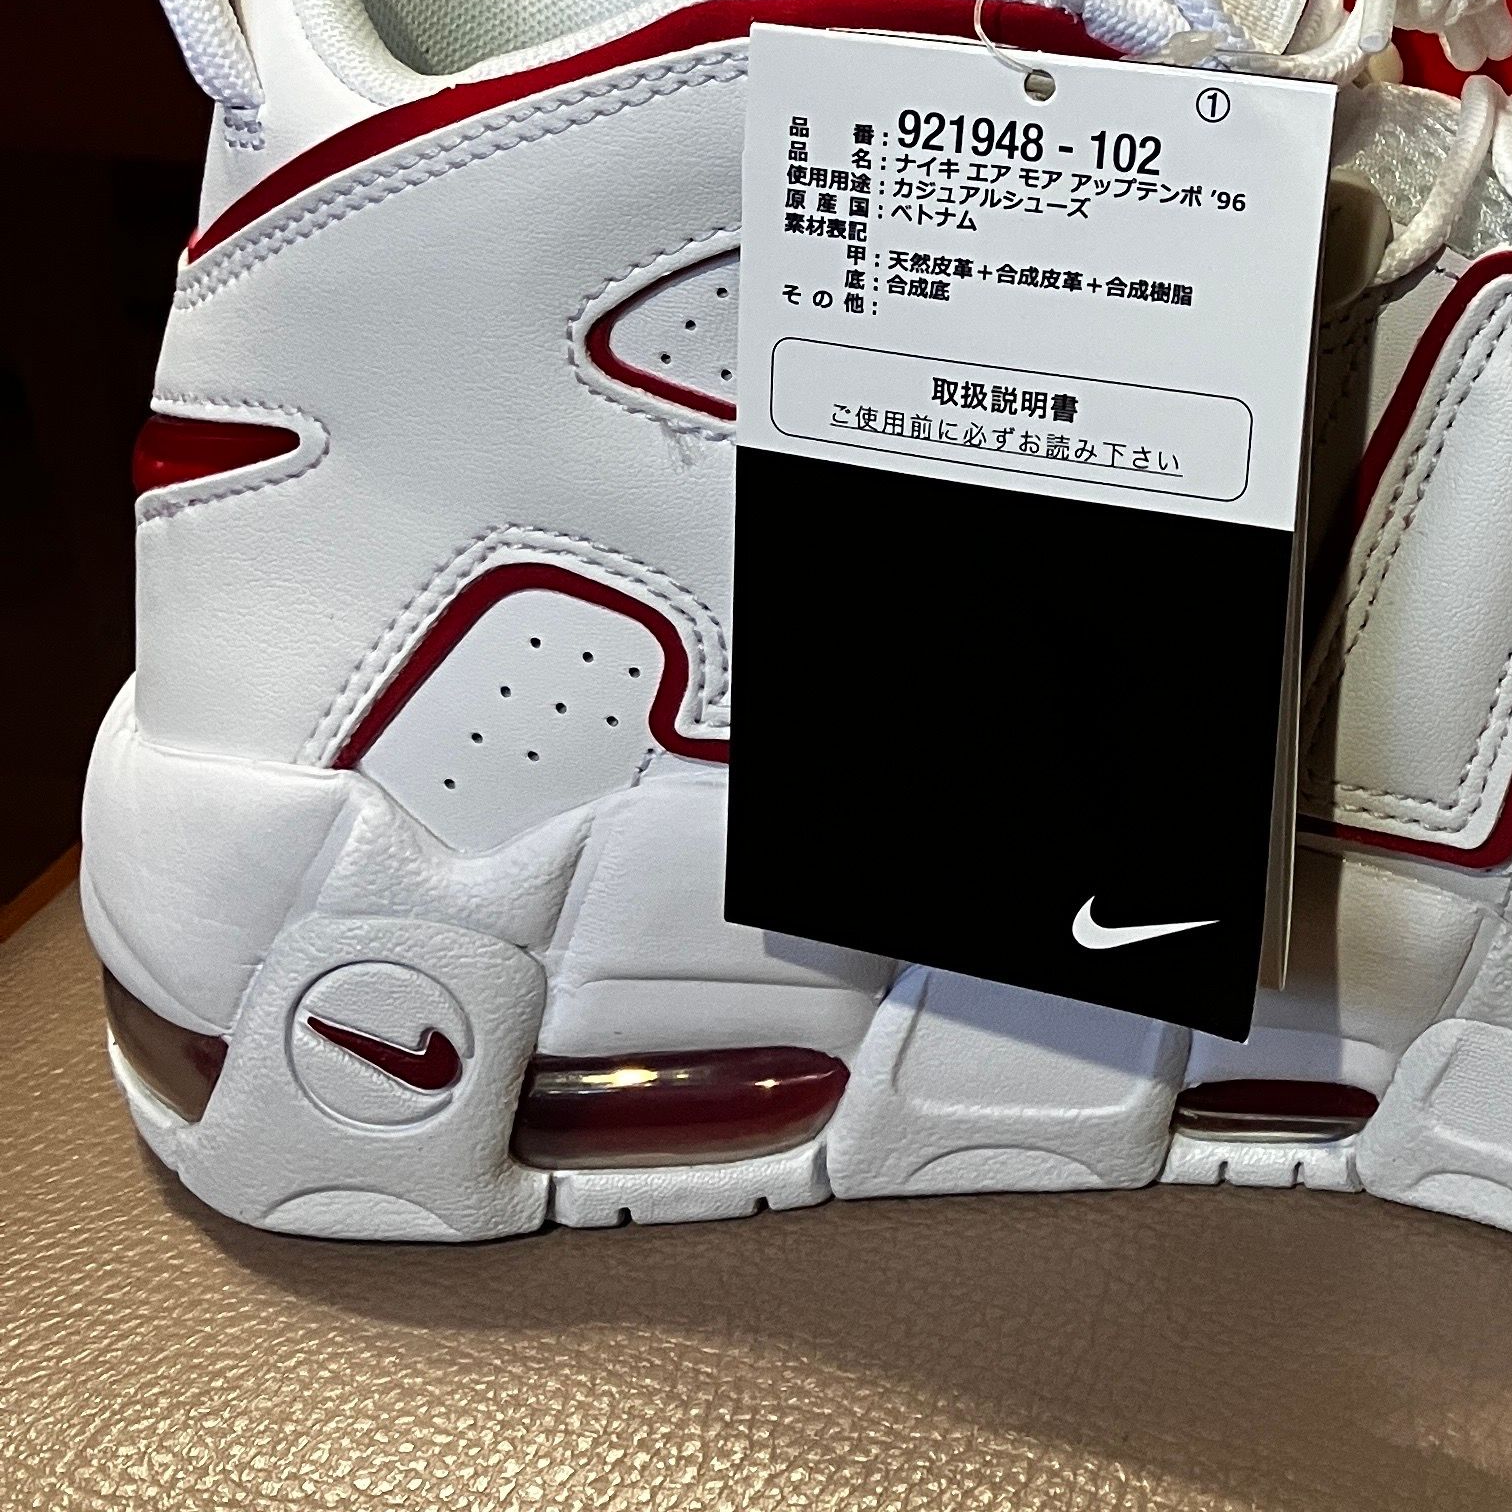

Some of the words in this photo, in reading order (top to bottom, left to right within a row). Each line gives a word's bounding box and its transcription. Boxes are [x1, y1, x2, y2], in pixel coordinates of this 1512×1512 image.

[784, 211, 868, 243] 素材表記
[931, 376, 1079, 424] 取扱説明書
[830, 402, 1181, 474] ご使用前に必ずお読み下さい
